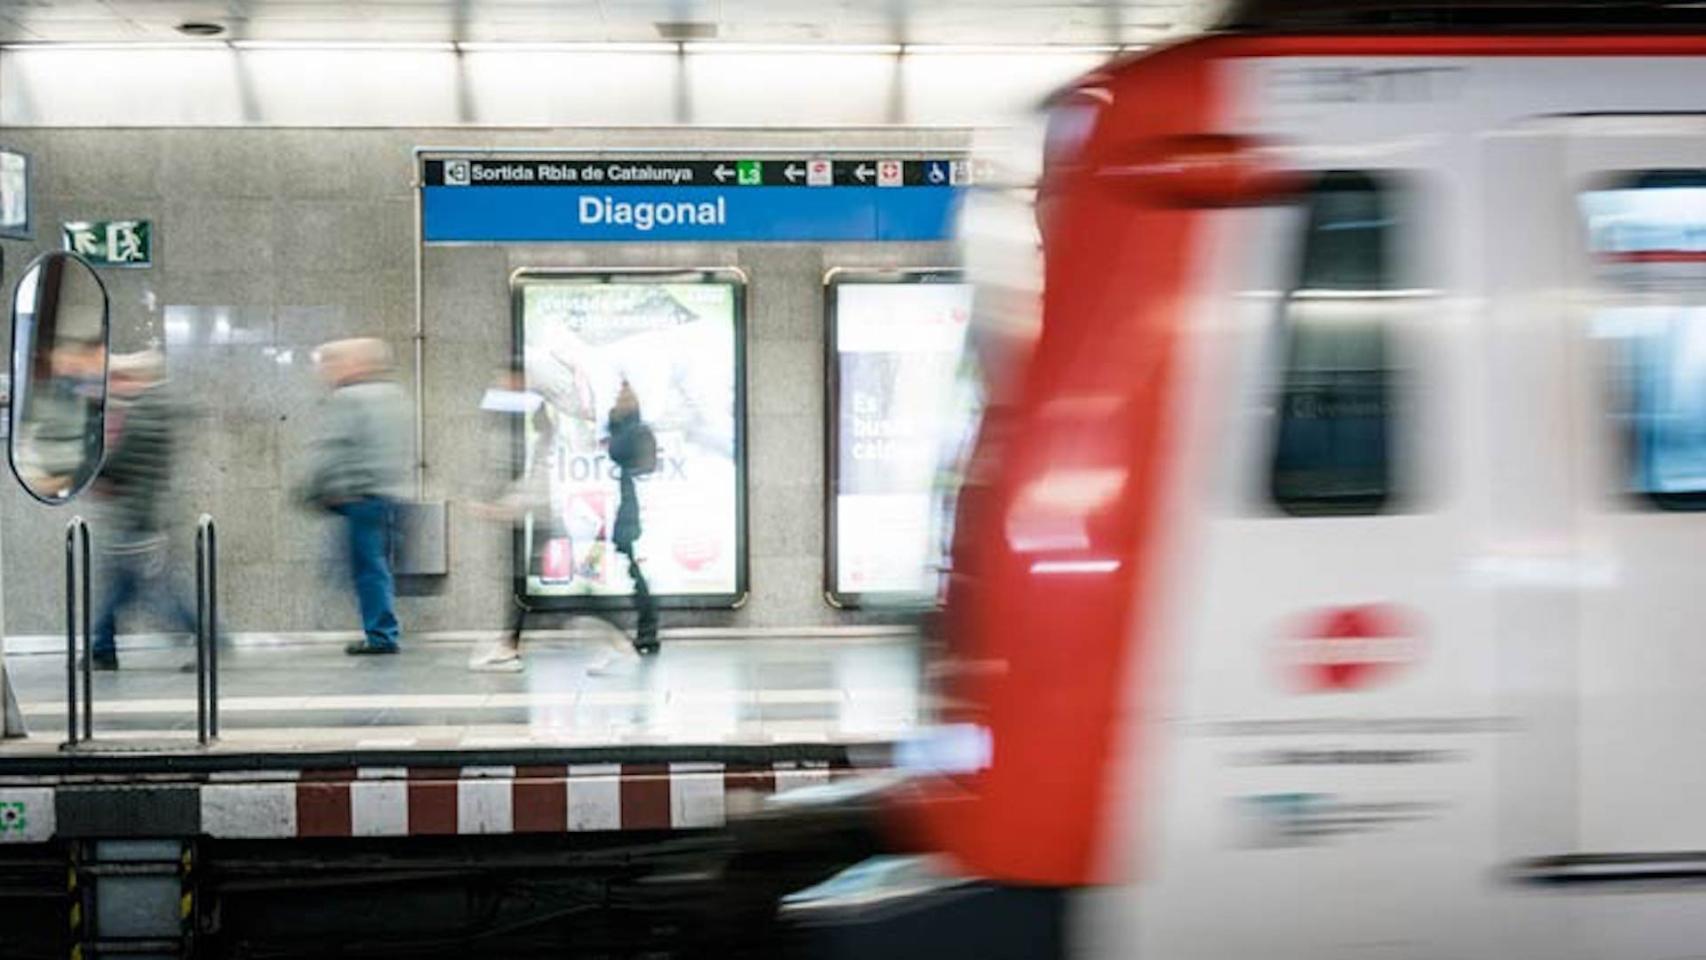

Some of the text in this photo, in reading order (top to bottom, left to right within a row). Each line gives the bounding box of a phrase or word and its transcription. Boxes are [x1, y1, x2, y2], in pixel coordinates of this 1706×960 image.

[472, 164, 692, 184] Sortida Rbla de Catalunya
[738, 168, 762, 185] L3
[578, 194, 726, 230] Diagonal
